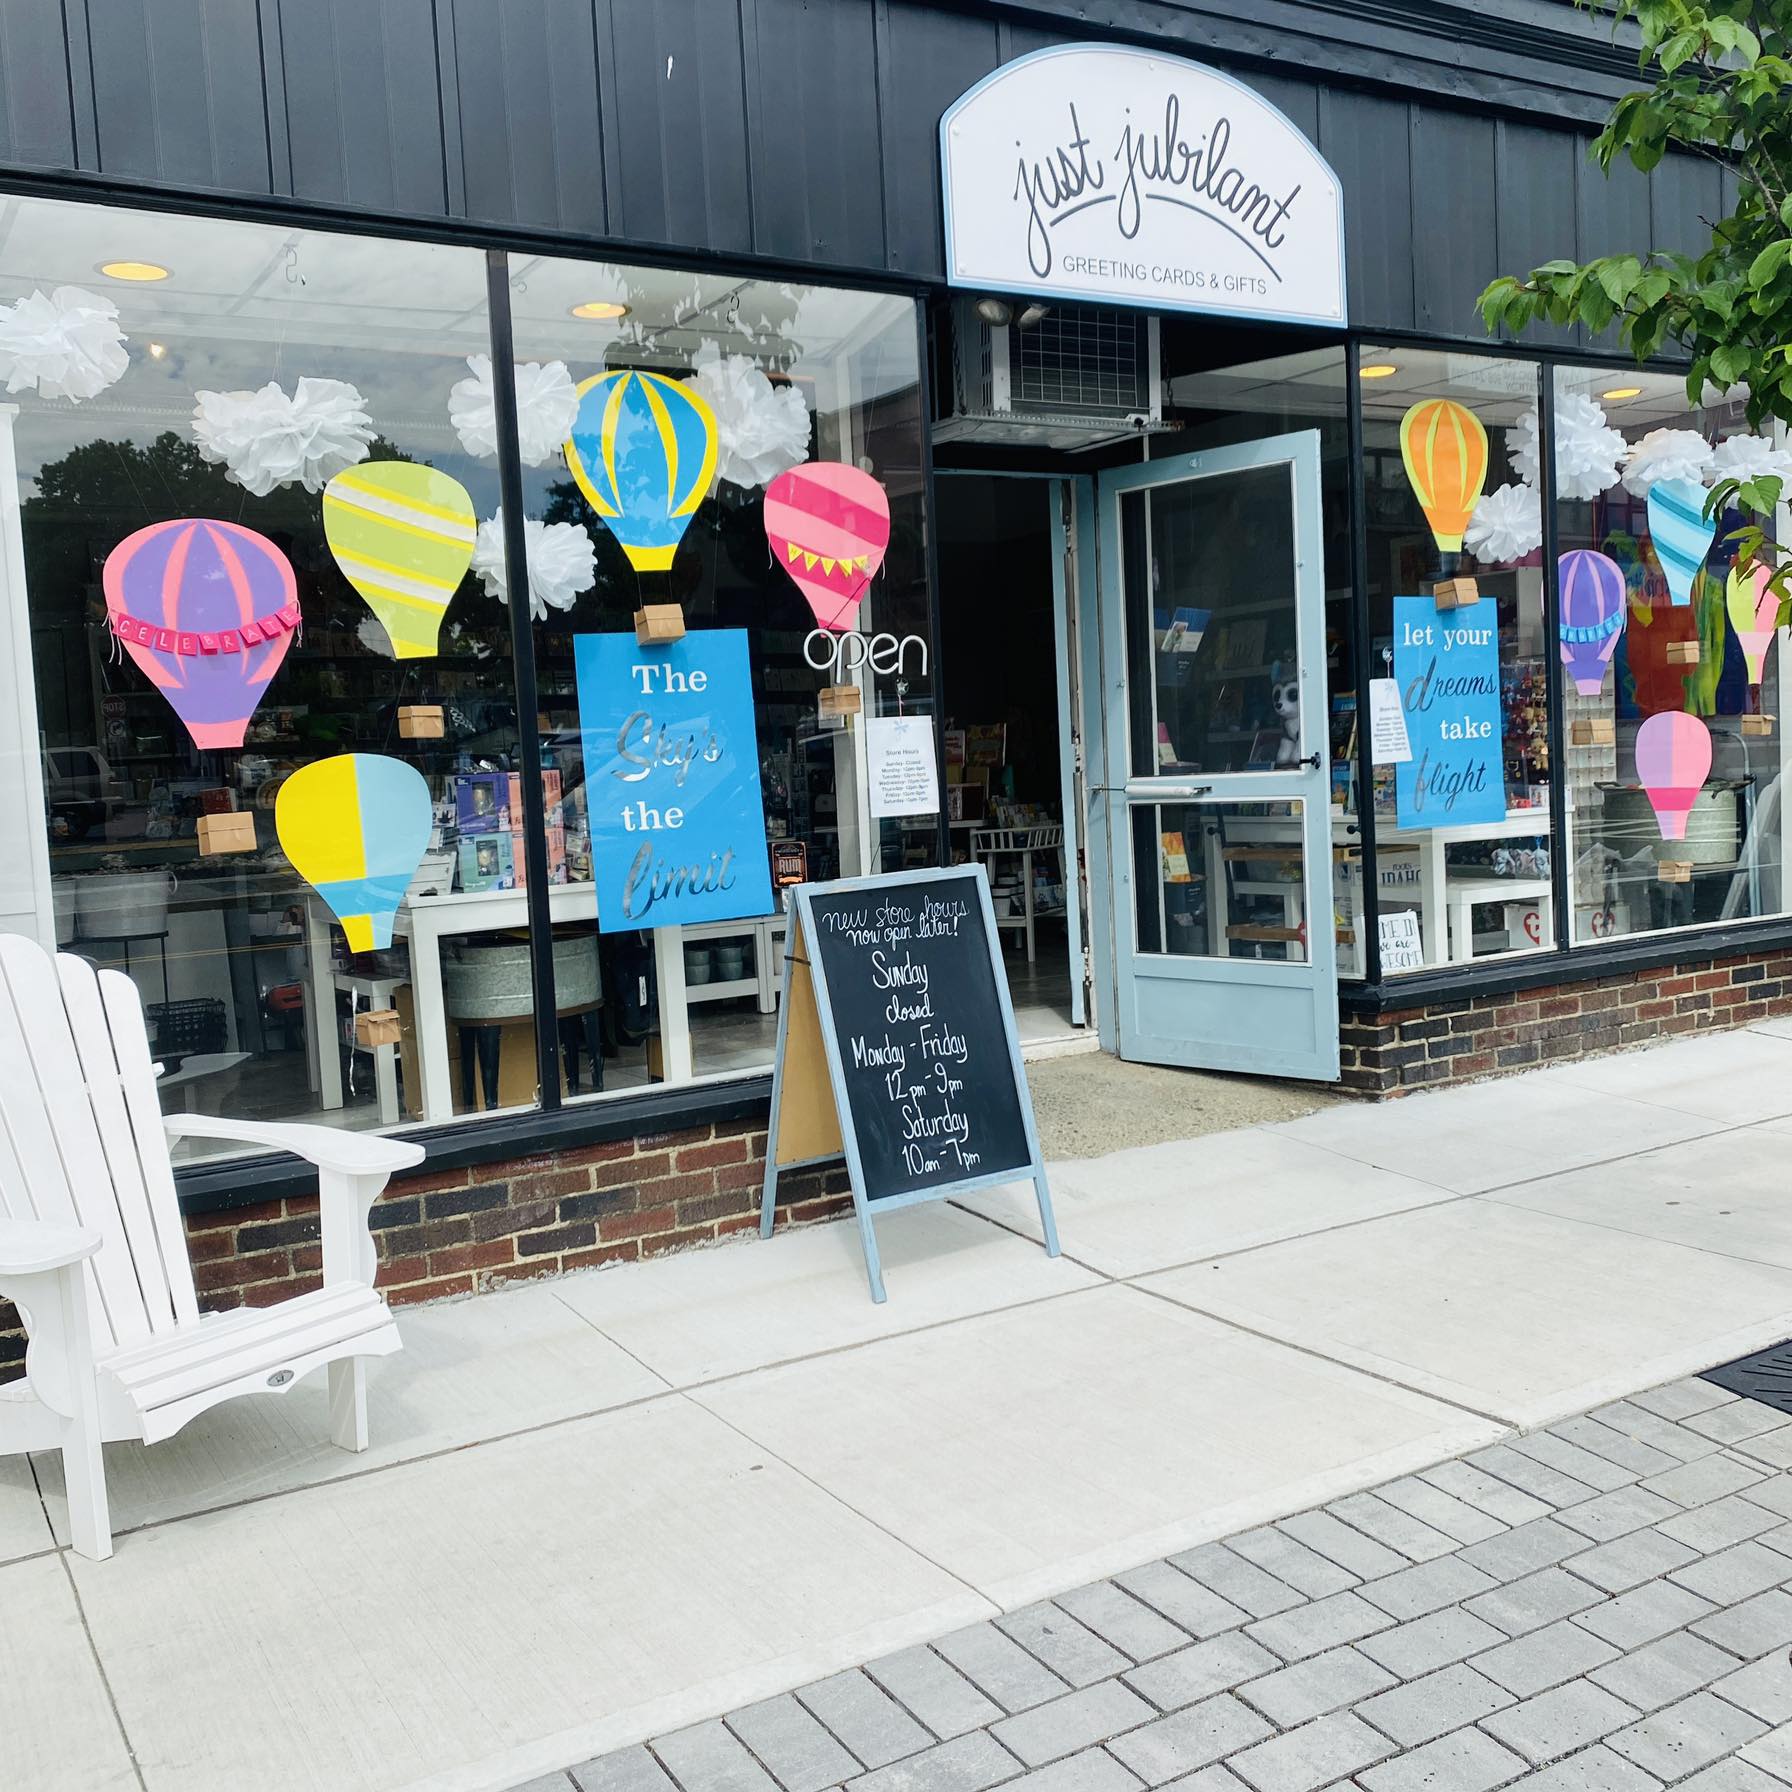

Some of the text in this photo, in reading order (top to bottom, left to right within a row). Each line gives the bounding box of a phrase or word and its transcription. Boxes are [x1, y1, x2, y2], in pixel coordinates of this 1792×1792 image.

[1013, 93, 1302, 278] just jubilant
[1062, 255, 1268, 296] GREETING CARDS & GIFTS
[118, 609, 297, 650] CELEBRATE
[1403, 621, 1492, 652] let your
[803, 628, 928, 684] open
[631, 662, 708, 695] The
[1404, 654, 1497, 714] dreams
[1439, 715, 1492, 740] take
[610, 711, 724, 788] Sky's
[1412, 747, 1487, 813] flight
[620, 800, 685, 832] the
[622, 840, 737, 920] limit
[822, 894, 970, 933] new store hours
[845, 926, 880, 947] now
[884, 925, 912, 951] open
[872, 950, 928, 994] Sunday
[885, 993, 935, 1024] closed
[851, 1033, 906, 1073] Monday
[919, 1023, 968, 1064] Friday
[902, 1099, 969, 1143] Saturday
